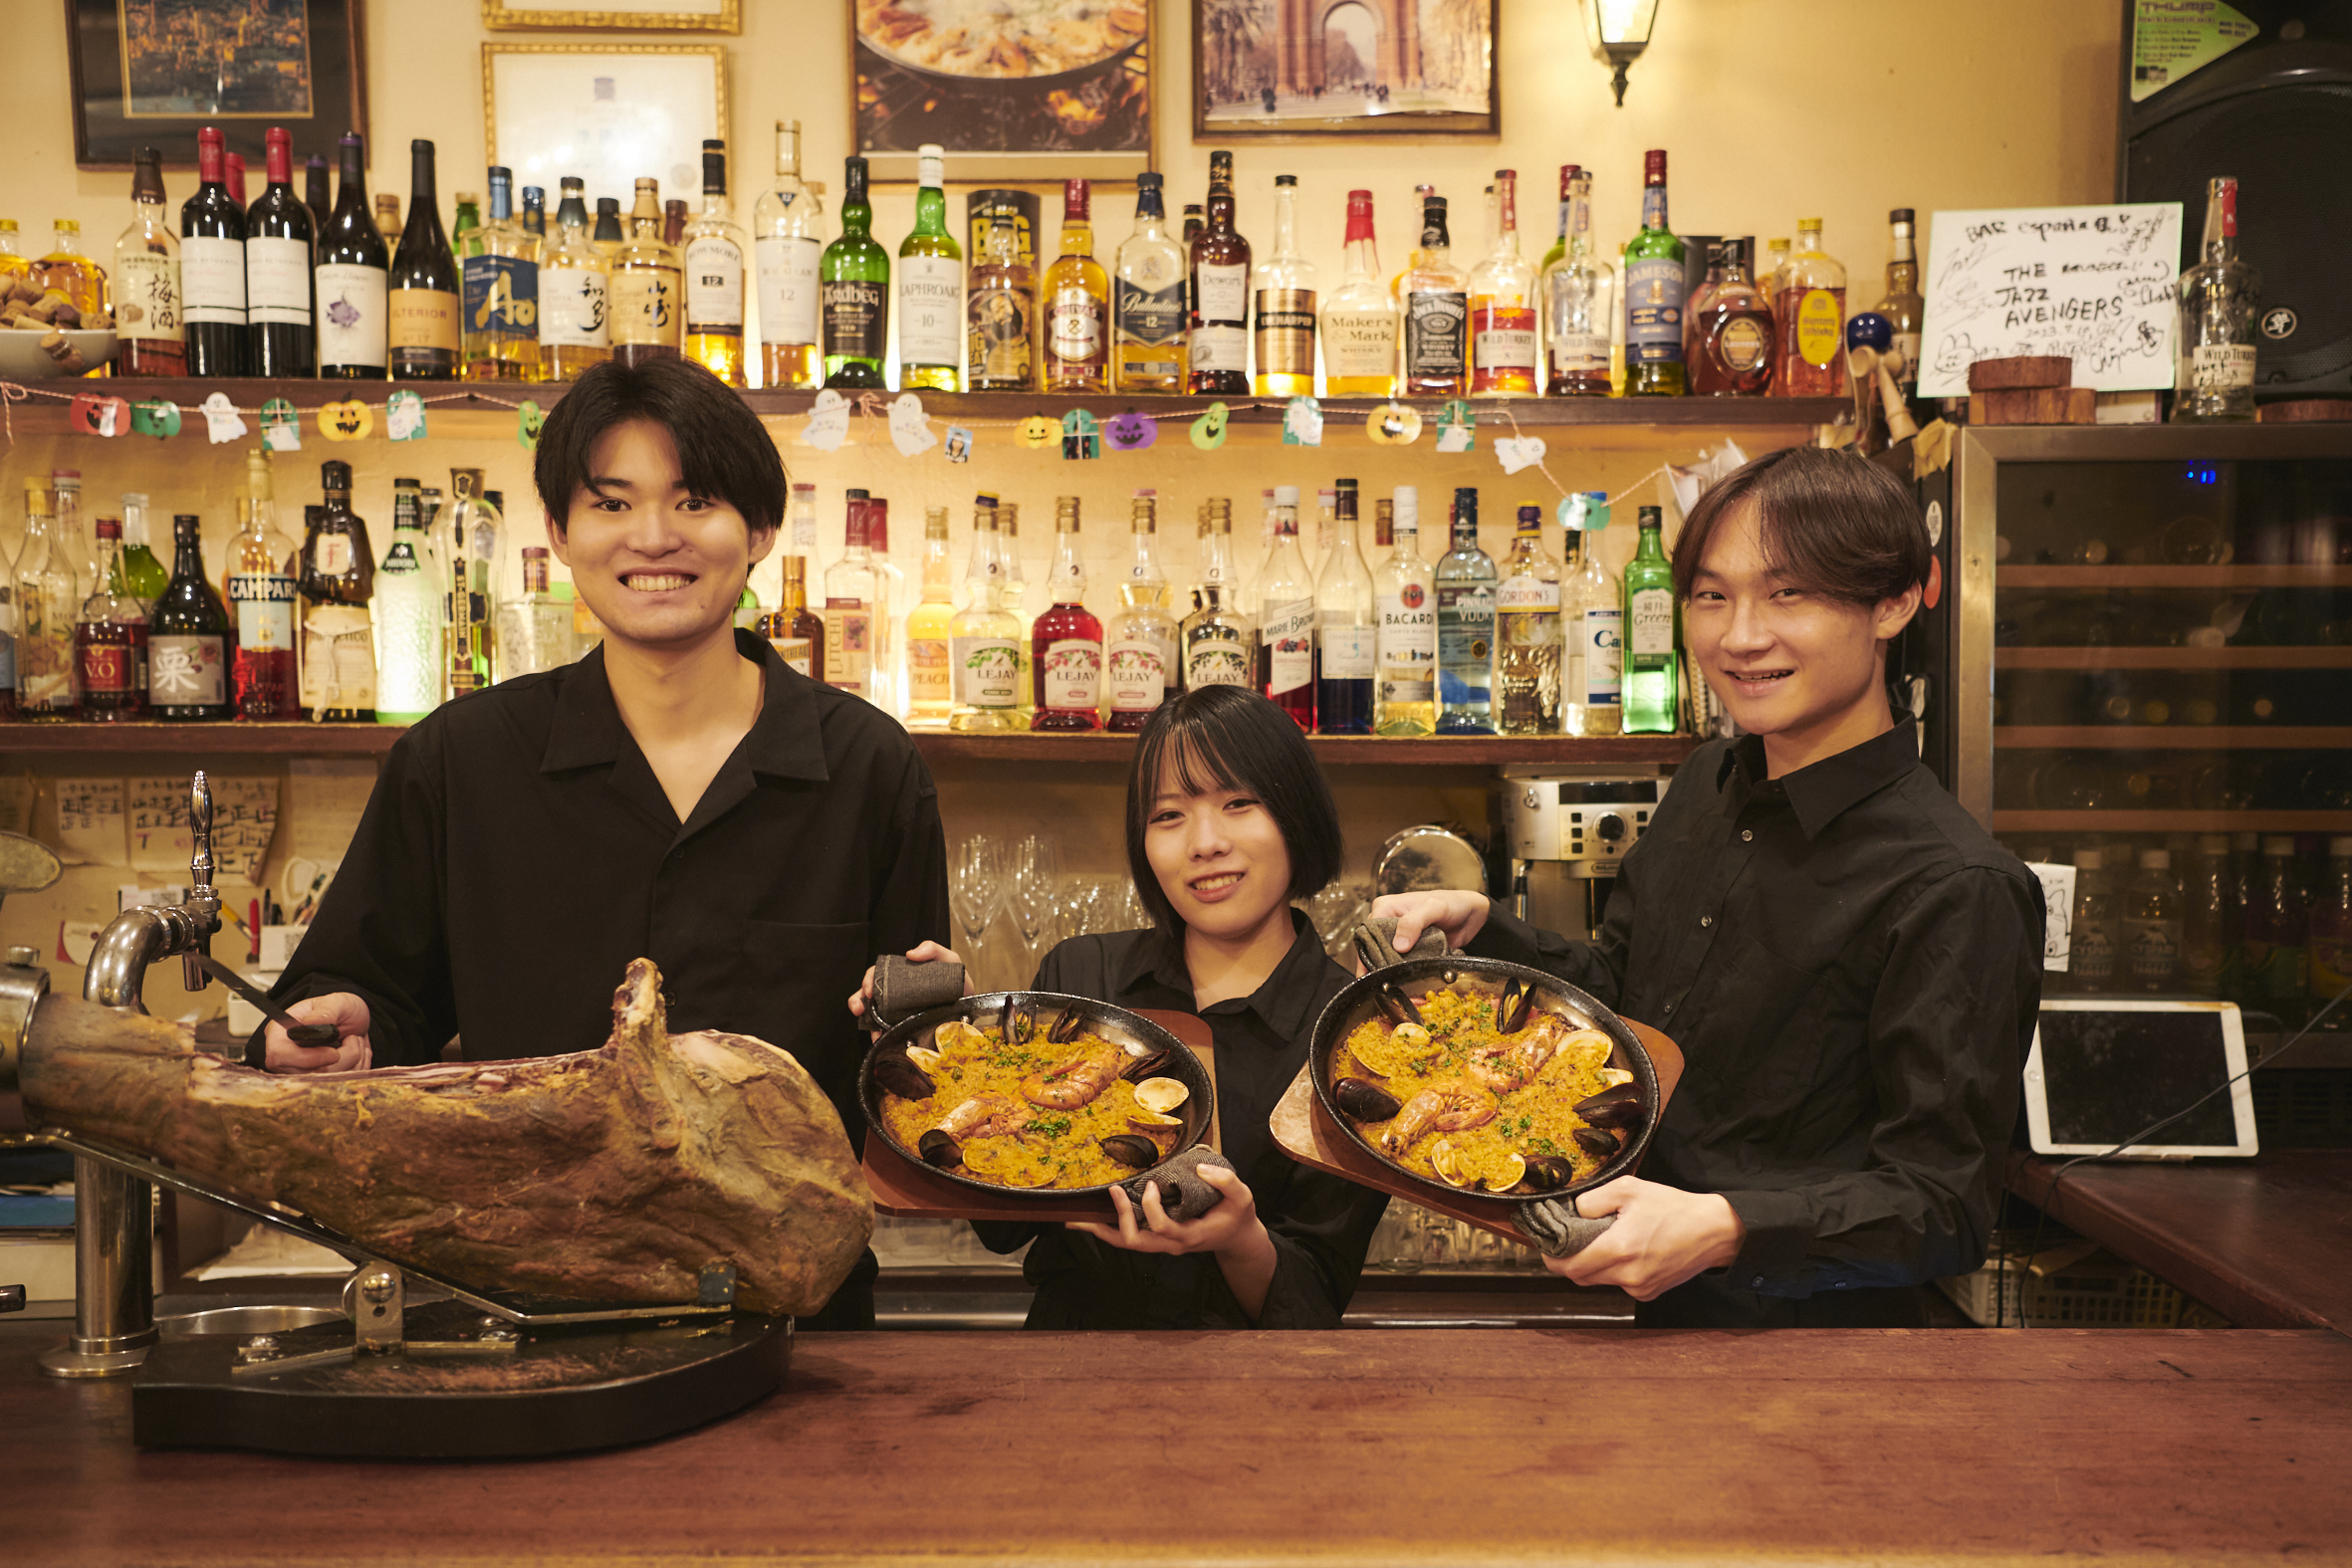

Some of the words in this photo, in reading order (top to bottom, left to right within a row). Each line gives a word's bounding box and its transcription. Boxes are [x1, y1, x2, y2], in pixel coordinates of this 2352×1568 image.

[1966, 221, 2006, 243] BAR
[2003, 263, 2046, 282] THE
[145, 272, 177, 330] 梅酒
[781, 289, 795, 301] 12
[1995, 287, 2049, 307] JAZZ
[2005, 296, 2122, 329] AVENGERS
[922, 314, 934, 328] 10
[1145, 316, 1158, 328] 12
[1331, 318, 1392, 328] Maker's
[1349, 331, 1392, 341] Mark
[1499, 590, 1549, 604] GORDON'S
[1634, 613, 1672, 626] Green
[1266, 622, 1290, 638] MARIE
[829, 617, 842, 673] LITCHI
[154, 646, 199, 694] 栗
[978, 670, 1017, 679] LEJAY
[1057, 671, 1096, 682] LEJAY
[1113, 671, 1152, 682] LEJAY
[1197, 673, 1240, 683] LEJAY
